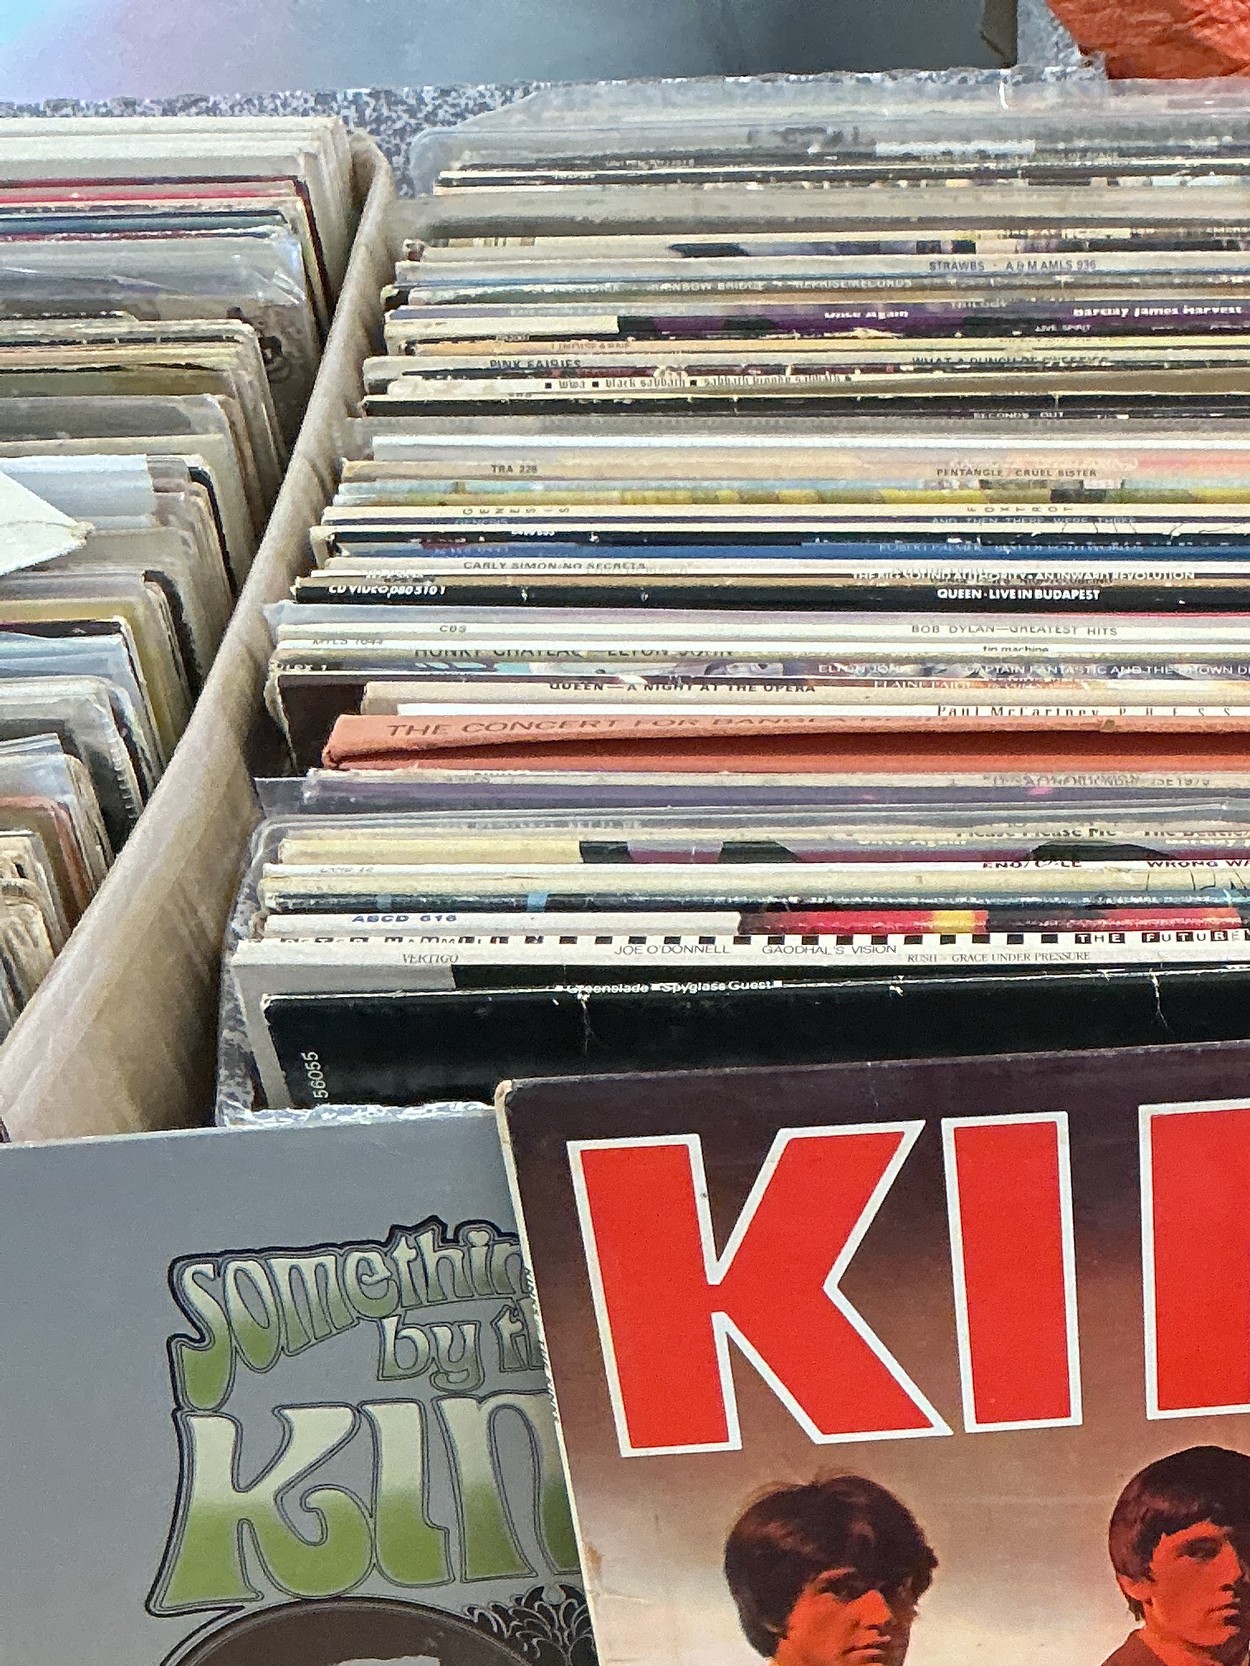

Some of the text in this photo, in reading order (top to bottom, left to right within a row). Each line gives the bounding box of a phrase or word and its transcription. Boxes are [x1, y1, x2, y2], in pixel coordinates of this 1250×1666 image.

[928, 260, 985, 271] STRAWBS
[491, 464, 514, 474] TRA
[936, 468, 1004, 478] PENTANGLE
[1015, 468, 1053, 478] CRUEL
[463, 561, 507, 570] CARLY
[511, 561, 557, 570] SIMON
[936, 588, 983, 601] QUEEN
[988, 589, 1017, 600] LIVE
[1017, 589, 1034, 600] IN
[1034, 588, 1101, 601] BUDAPEST
[439, 624, 467, 633] CBS
[911, 624, 941, 634] BOB
[1086, 626, 1118, 637] HITS
[965, 664, 1026, 674] CAPTAIN
[1030, 664, 1108, 675] FANTASTIC
[1110, 664, 1143, 675] AND
[1145, 664, 1174, 675] THE
[549, 682, 604, 691] QUEEN
[643, 682, 694, 692] NIGHT
[700, 683, 719, 692] AT
[728, 683, 757, 692] THE
[762, 684, 817, 693] OPERA
[937, 704, 981, 717] Paul
[385, 722, 453, 738] THE
[460, 719, 619, 735] CONCERT
[351, 914, 410, 923] ABCD
[419, 914, 458, 923] 616
[1074, 933, 1127, 945] THE
[614, 945, 645, 955] JOE
[646, 944, 732, 955] O'DONNELL
[851, 944, 898, 954] VISION
[401, 951, 1091, 964] VERTIGO RUSH GRACE UNDER PRESSURE
[567, 979, 773, 995] Greenslade Spyglass Guest
[299, 1051, 330, 1100] 56055
[377, 1312, 484, 1393] by
